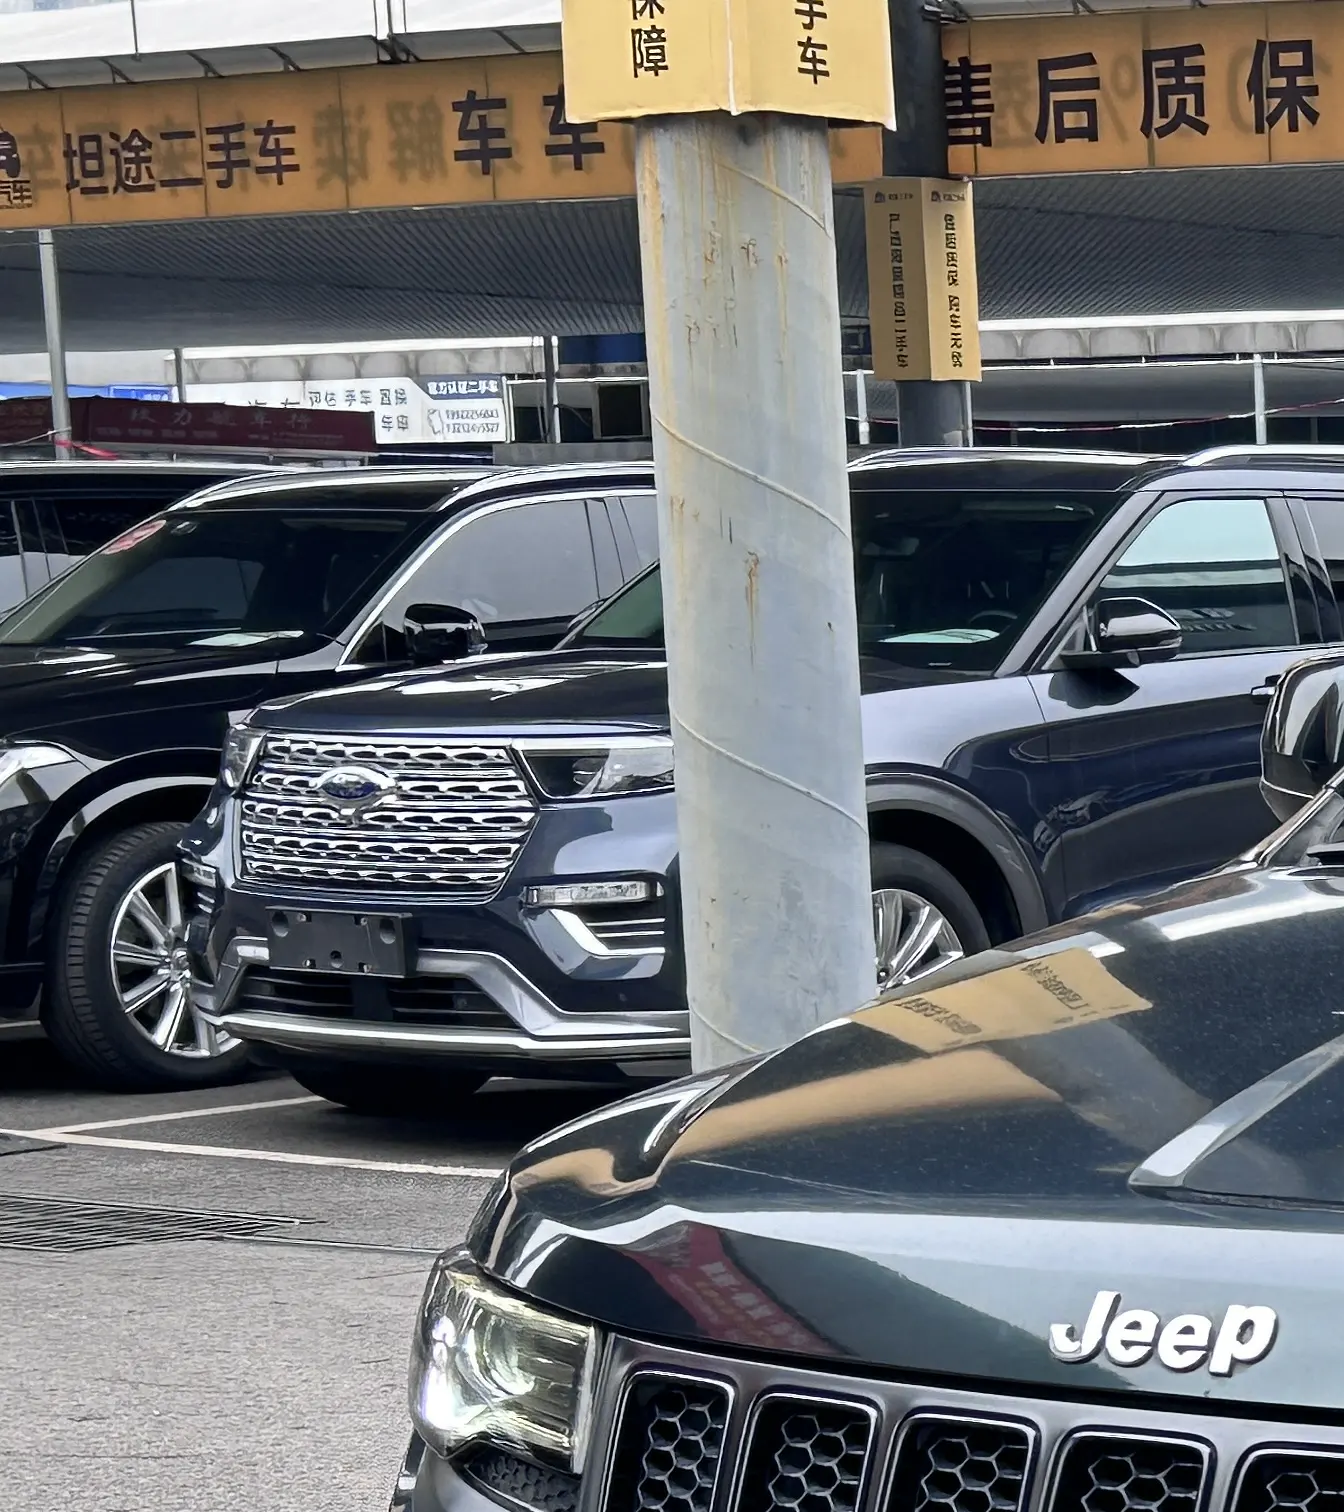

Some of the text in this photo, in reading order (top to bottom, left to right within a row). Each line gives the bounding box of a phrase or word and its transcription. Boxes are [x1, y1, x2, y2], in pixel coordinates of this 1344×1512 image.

[944, 39, 1321, 148] 售后质保
[63, 118, 300, 195] 坦途二手车
[1050, 1290, 1278, 1377] Jeep
